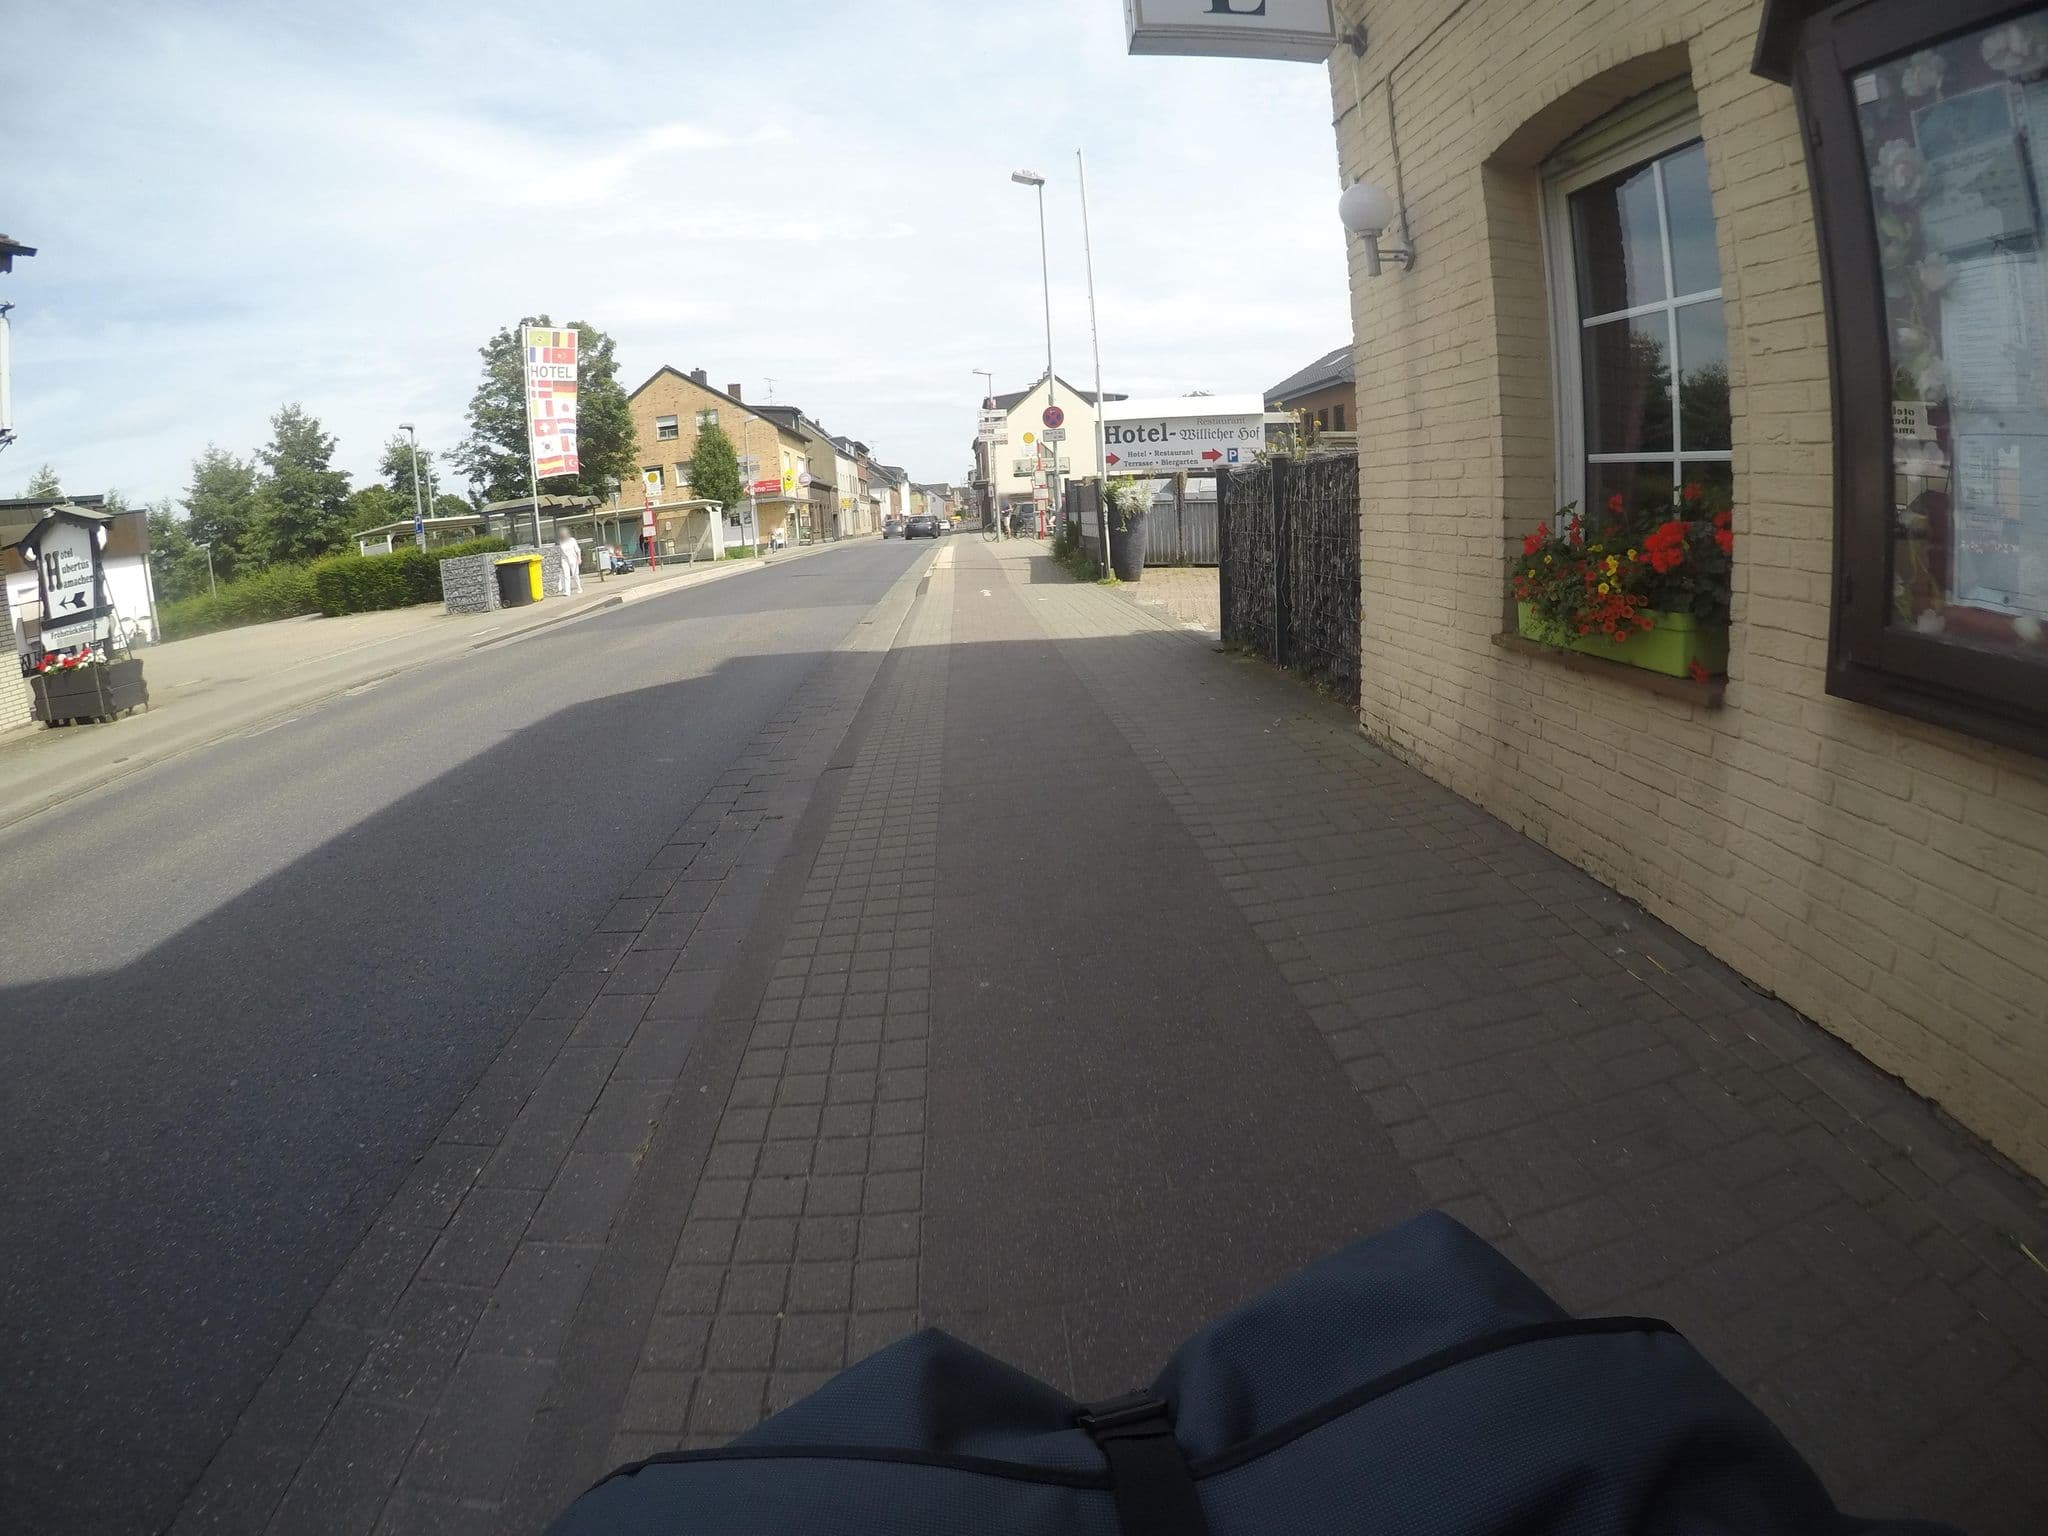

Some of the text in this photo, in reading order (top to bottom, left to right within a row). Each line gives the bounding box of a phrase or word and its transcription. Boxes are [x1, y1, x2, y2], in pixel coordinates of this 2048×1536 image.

[530, 366, 573, 379] HOTEL
[1196, 416, 1246, 425] Restaurant
[1179, 428, 1234, 442] Willicher
[1237, 426, 1260, 441] Hof
[1127, 449, 1194, 458] Hotel Restaurant
[1160, 459, 1199, 467] Biergarten
